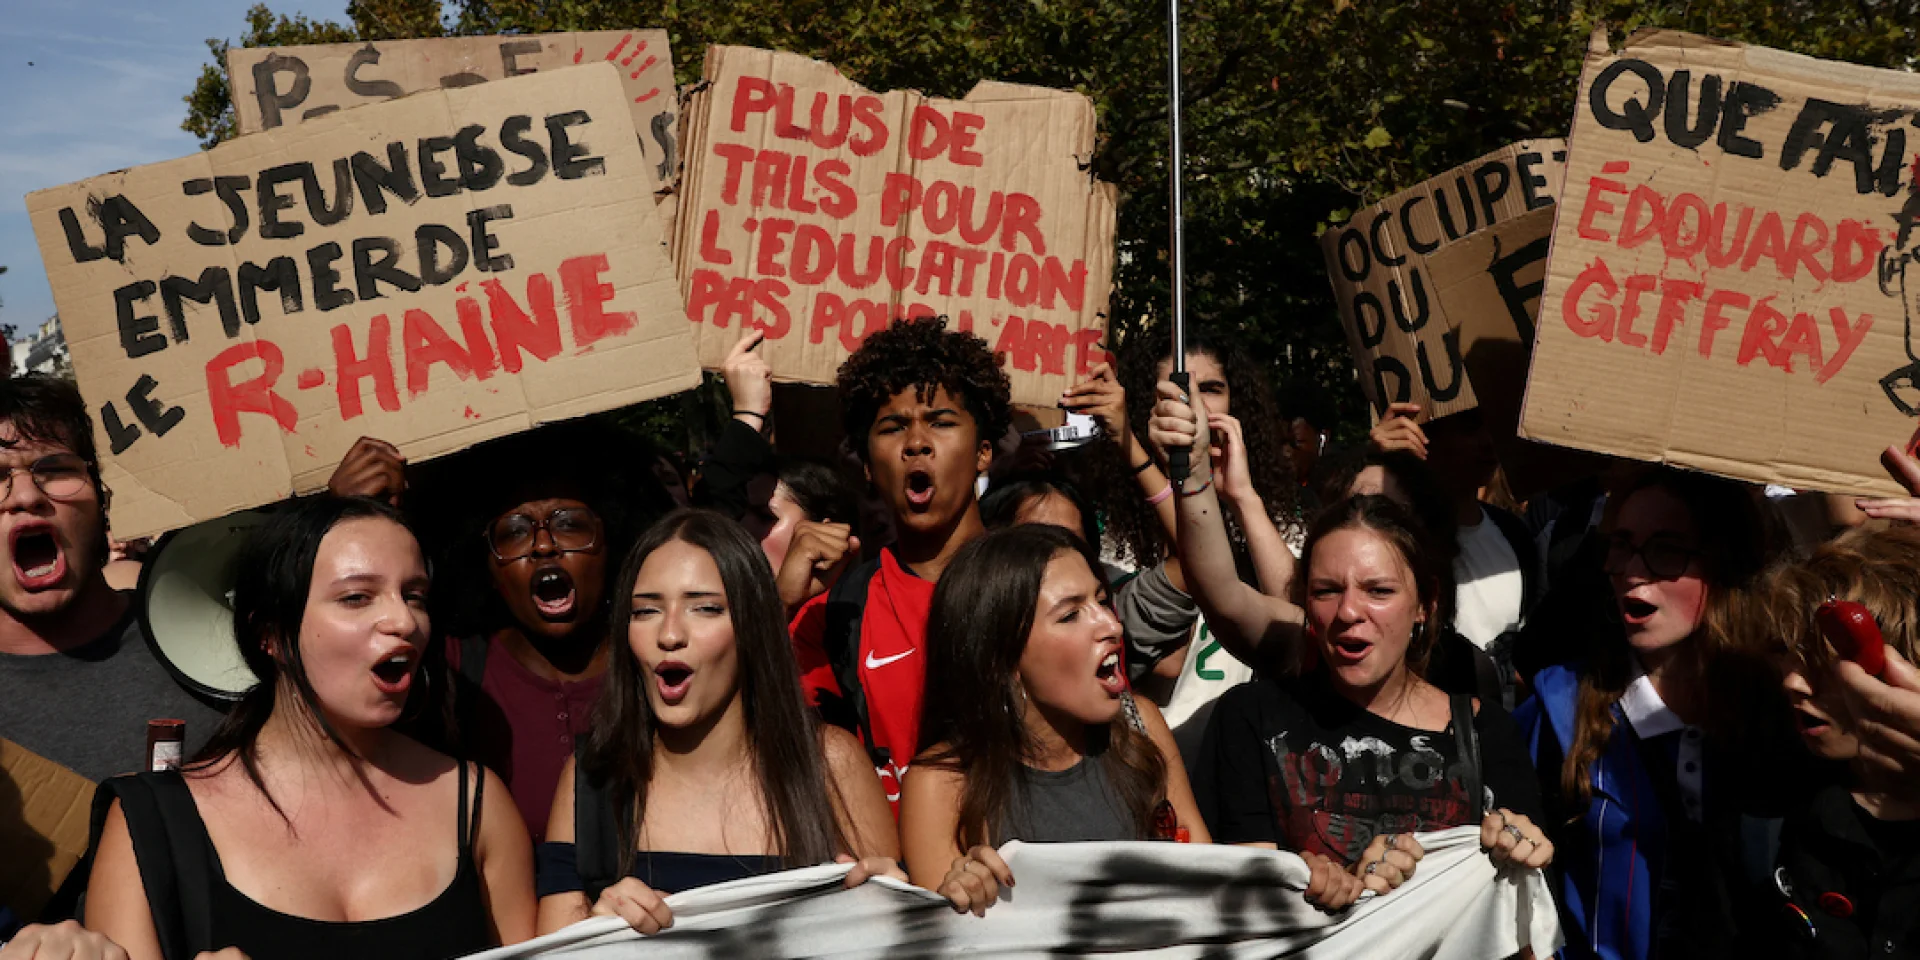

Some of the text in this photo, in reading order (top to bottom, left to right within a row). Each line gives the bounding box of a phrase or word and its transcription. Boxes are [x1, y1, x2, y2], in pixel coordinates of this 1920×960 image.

[731, 75, 889, 156] PLUS
[908, 106, 985, 167] DE
[1590, 58, 1920, 197] QUE FAI
[58, 194, 160, 263] LA
[183, 109, 605, 245] JEUNESSE
[880, 172, 1045, 255] POUR
[1339, 151, 1568, 281] OCCUPE
[1577, 161, 1884, 283] ÉDOUARD
[113, 204, 515, 358] EMMERDE
[687, 269, 791, 339] PAS
[700, 209, 1088, 311] L'EDUCATION
[1354, 269, 1429, 349] DU
[1373, 328, 1463, 415] DU
[1561, 257, 1875, 386] GEFFRAY
[100, 374, 186, 455] LE
